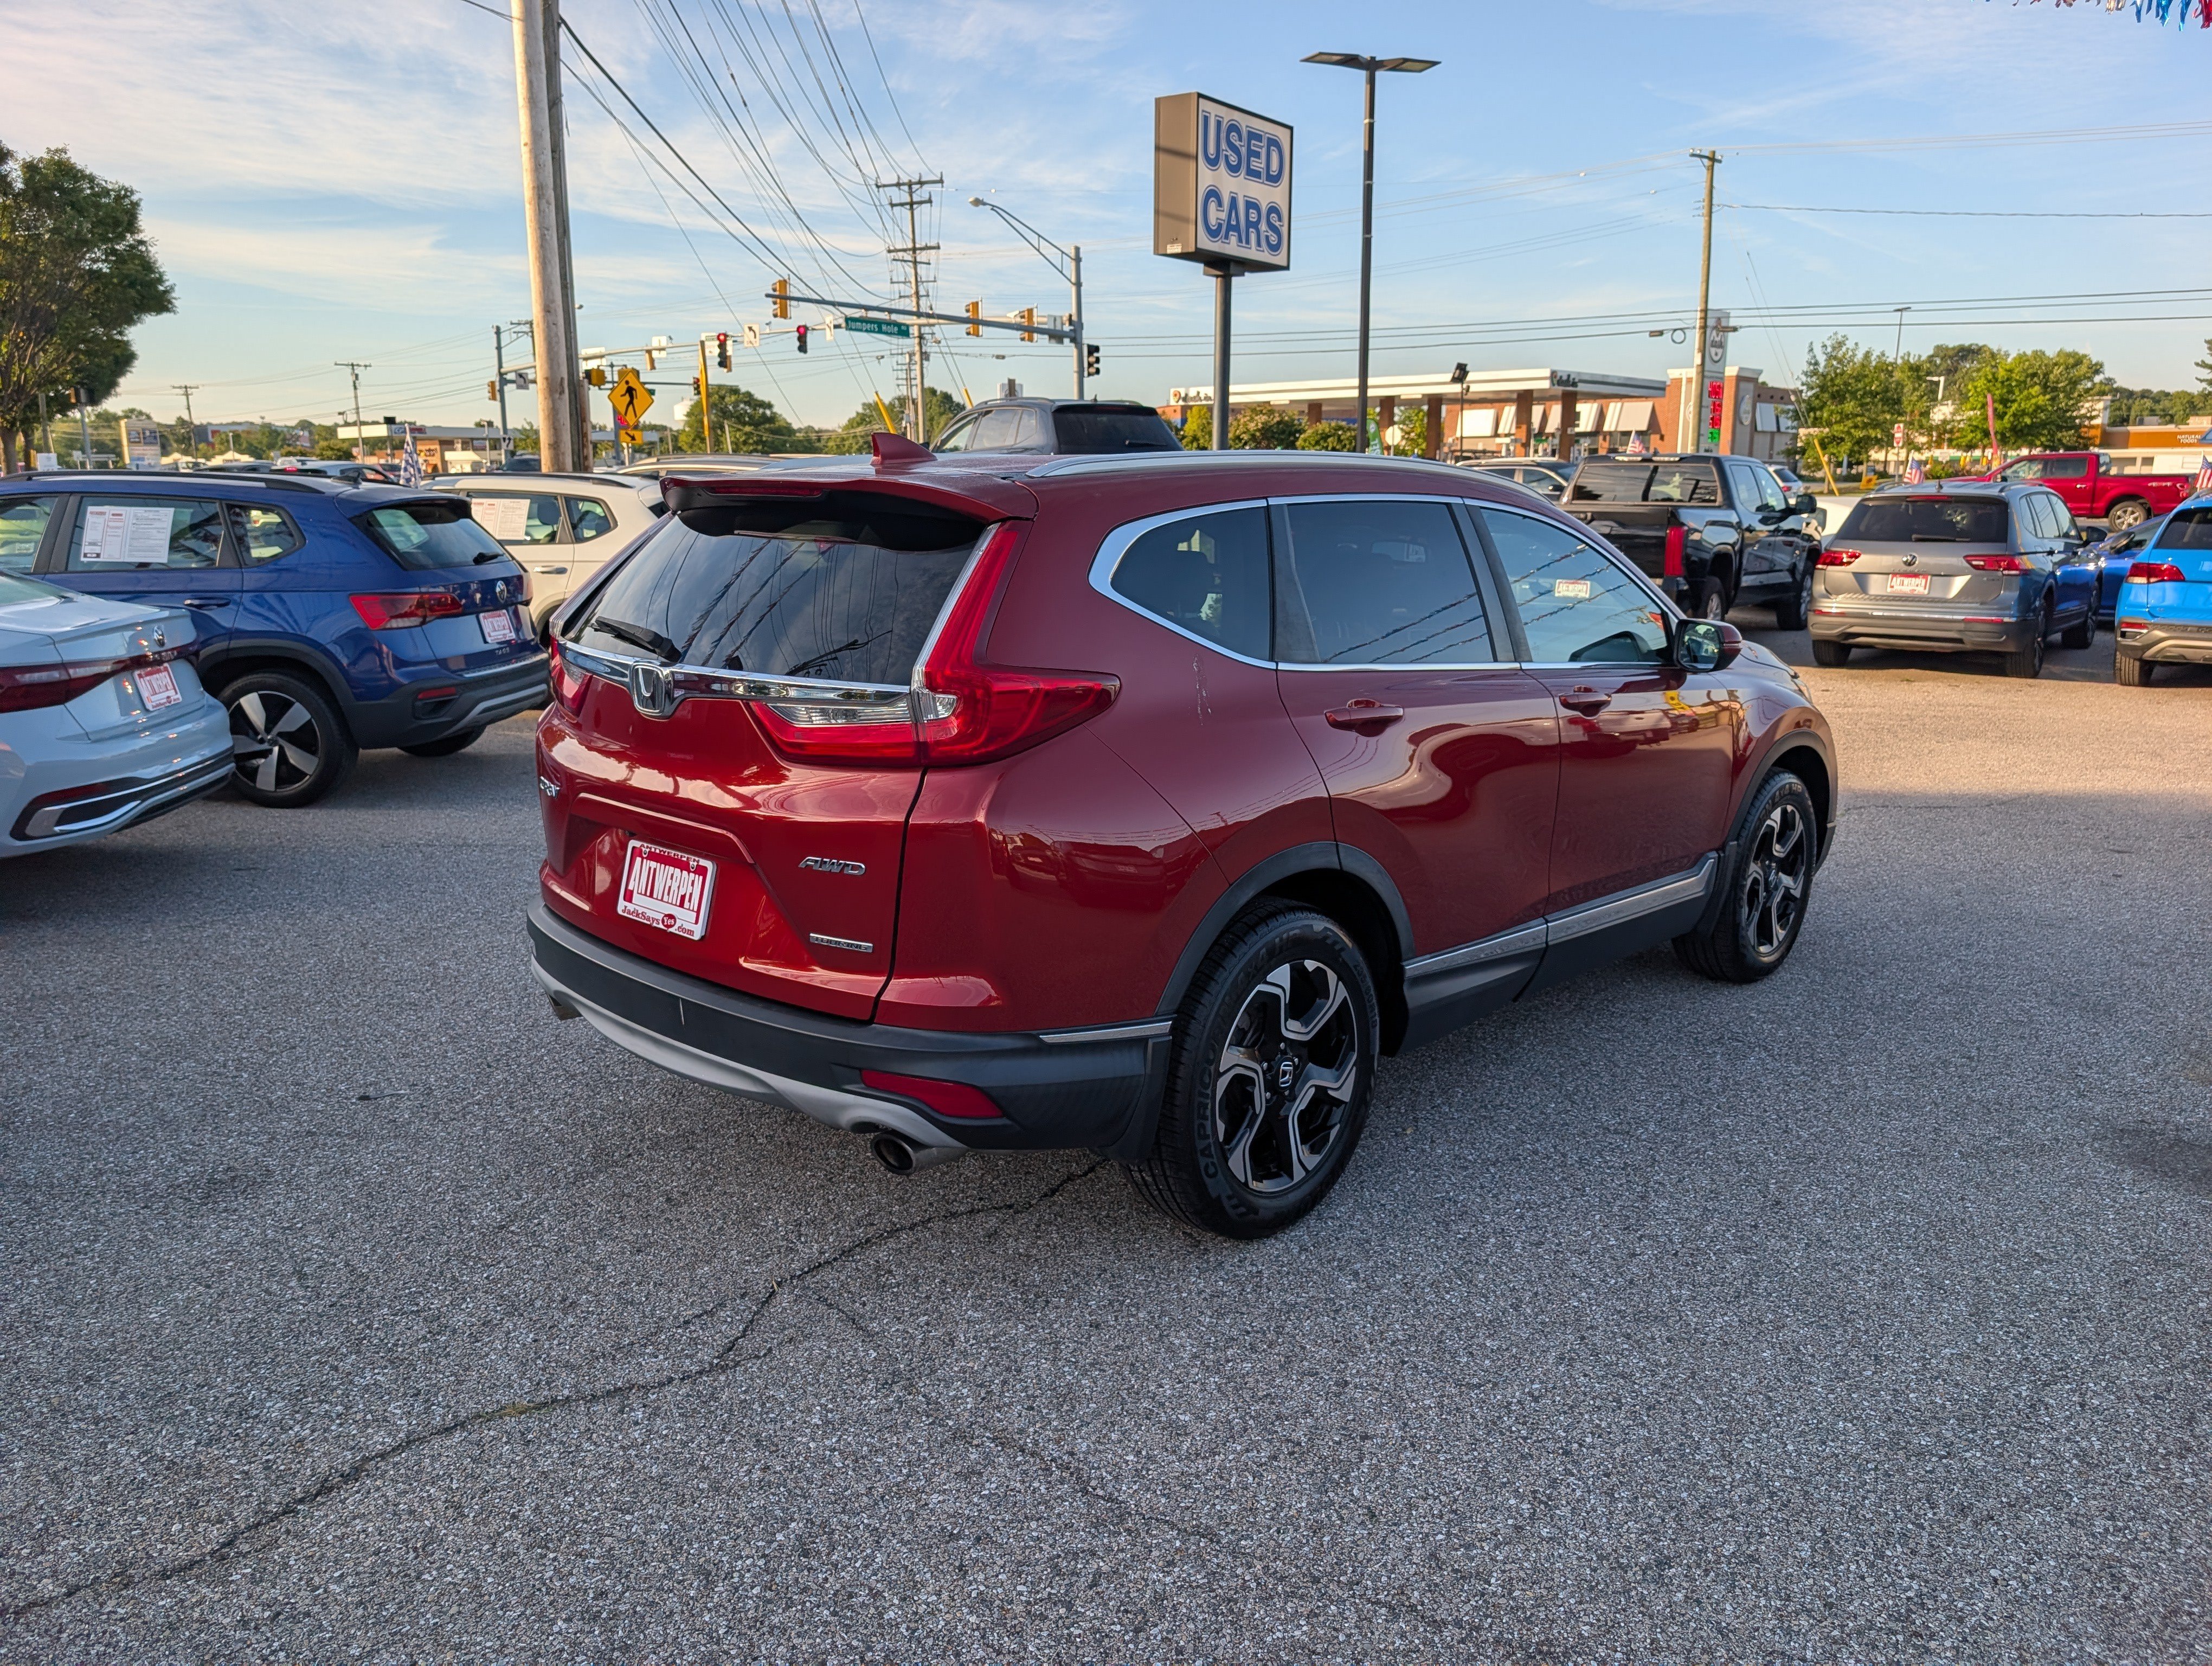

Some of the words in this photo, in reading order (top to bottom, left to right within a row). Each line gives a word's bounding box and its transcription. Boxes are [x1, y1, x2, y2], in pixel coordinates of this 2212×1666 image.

[1201, 110, 1285, 188] USED
[1200, 184, 1284, 257] CARS
[848, 320, 878, 332] Jumpers
[882, 324, 898, 334] Hole
[640, 843, 700, 865] ANTWERPEN
[798, 856, 866, 876] AWD
[628, 856, 703, 912] ANTWERPEN
[813, 936, 869, 952] TOURING
